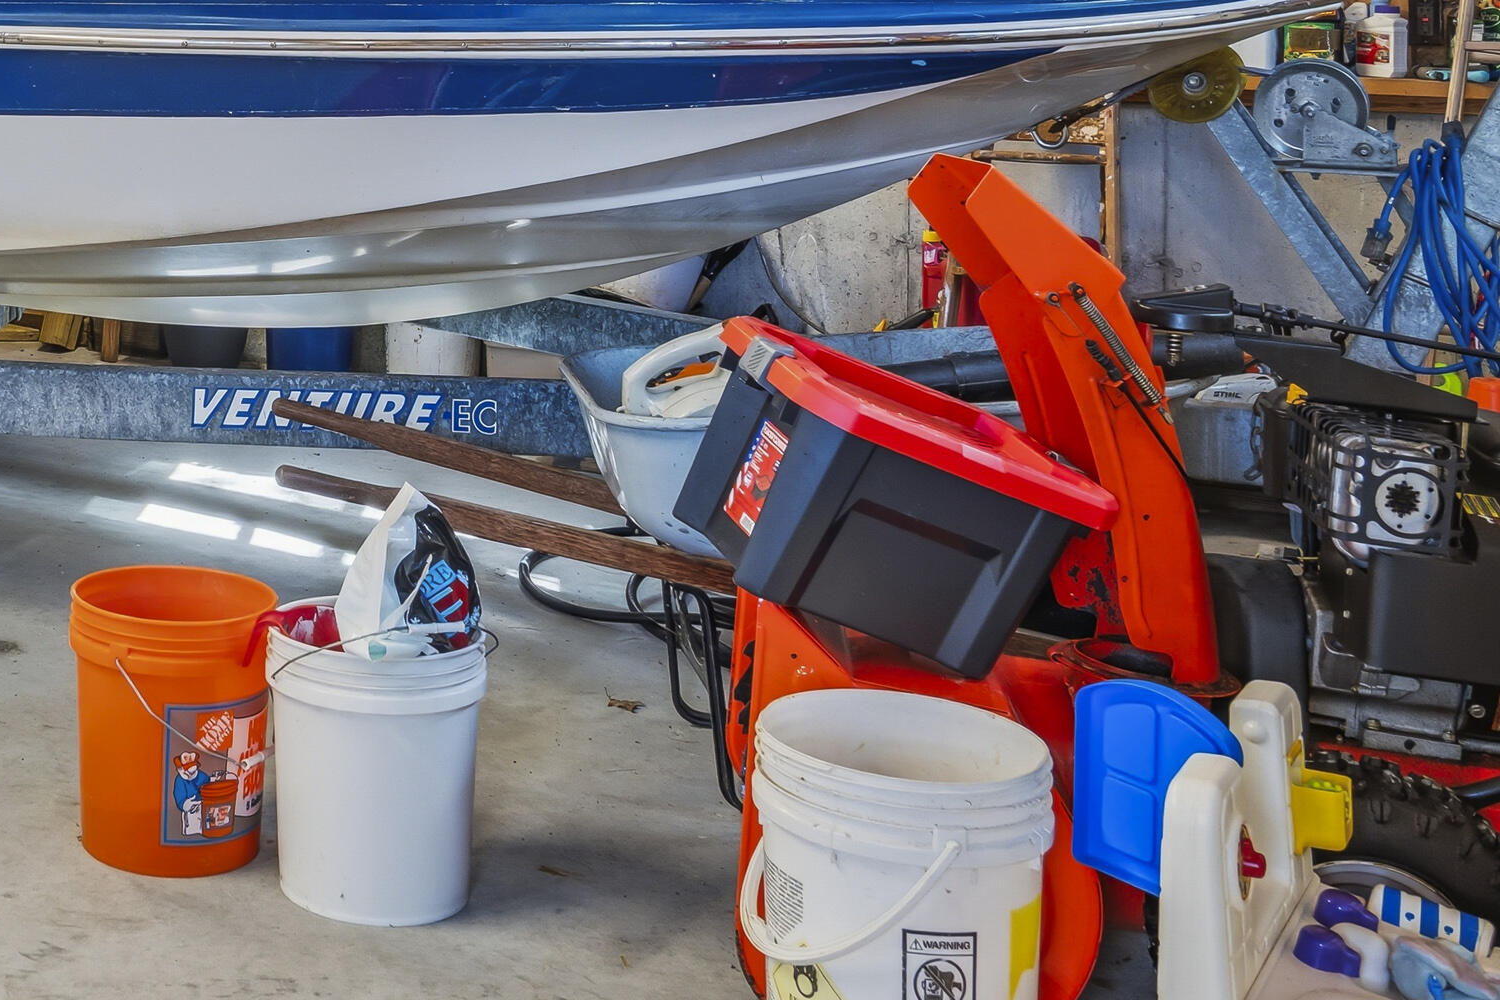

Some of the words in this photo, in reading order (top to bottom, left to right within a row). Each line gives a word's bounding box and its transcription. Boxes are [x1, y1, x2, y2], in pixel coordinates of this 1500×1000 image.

[1213, 390, 1243, 399] STIHL
[192, 387, 442, 434] VENTURE
[451, 399, 498, 435] EC
[923, 940, 971, 951] WARNING
